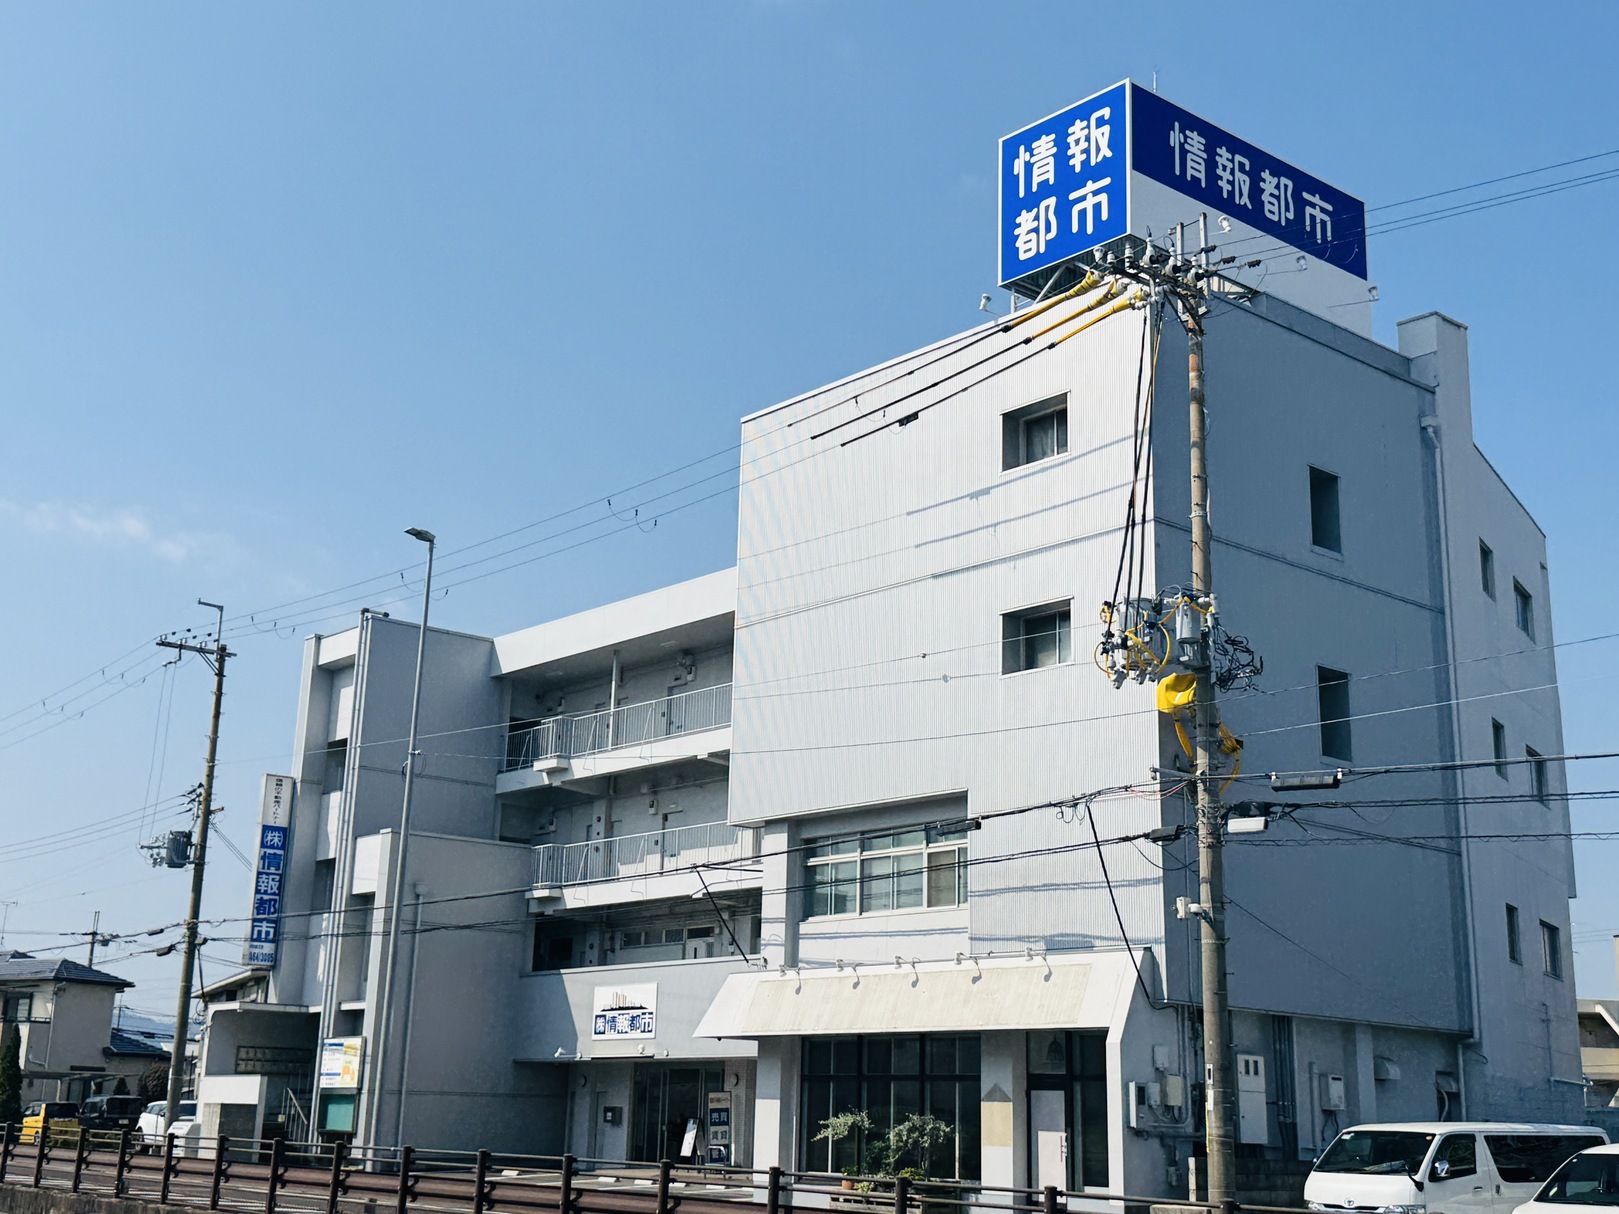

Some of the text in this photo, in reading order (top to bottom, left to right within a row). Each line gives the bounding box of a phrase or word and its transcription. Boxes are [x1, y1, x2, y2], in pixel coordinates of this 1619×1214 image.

[1013, 106, 1113, 198] 情報
[1169, 121, 1334, 244] 情報都市
[1013, 176, 1112, 261] 都市
[711, 1112, 728, 1122] 売買
